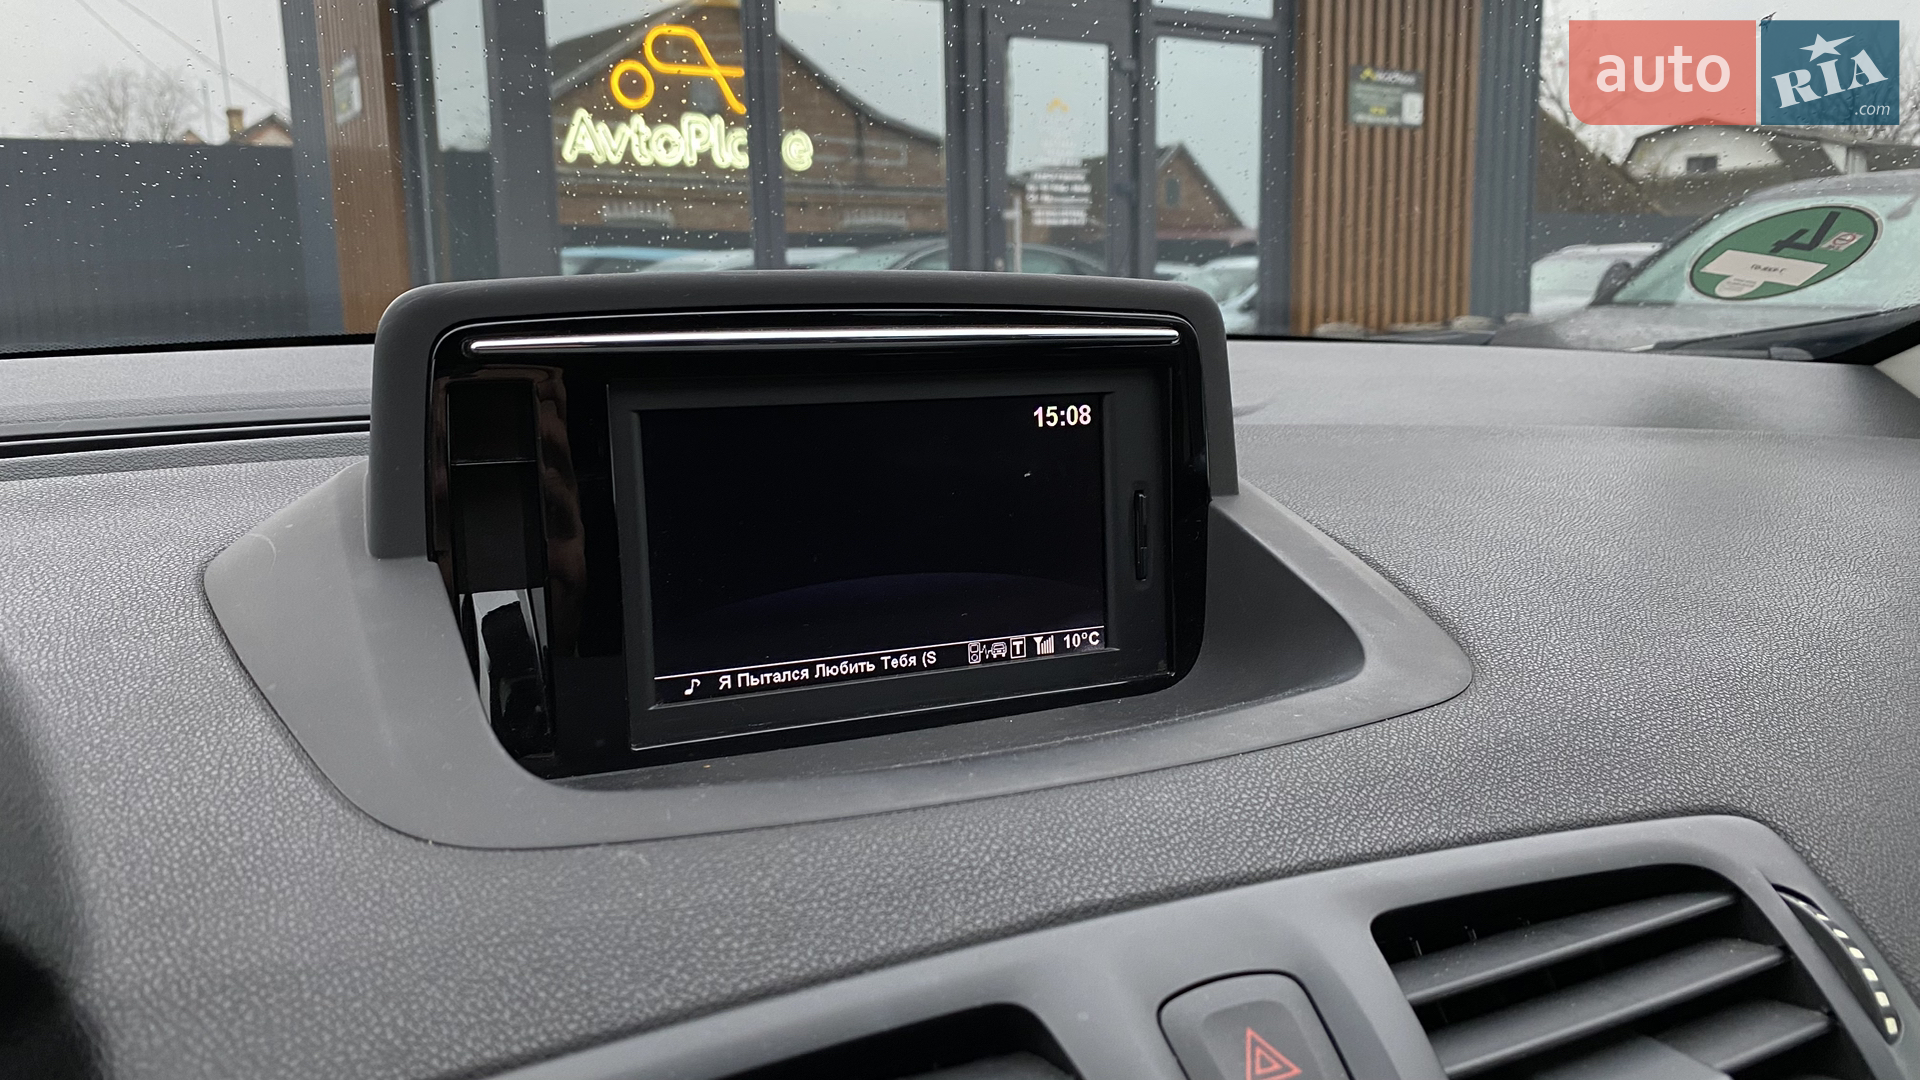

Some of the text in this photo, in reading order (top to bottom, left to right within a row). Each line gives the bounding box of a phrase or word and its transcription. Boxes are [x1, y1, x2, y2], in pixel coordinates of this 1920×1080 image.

[1033, 404, 1092, 428] 15:08
[1063, 631, 1100, 649] 10°C
[718, 651, 937, 690] Я Пытался Любить Тебя (S
